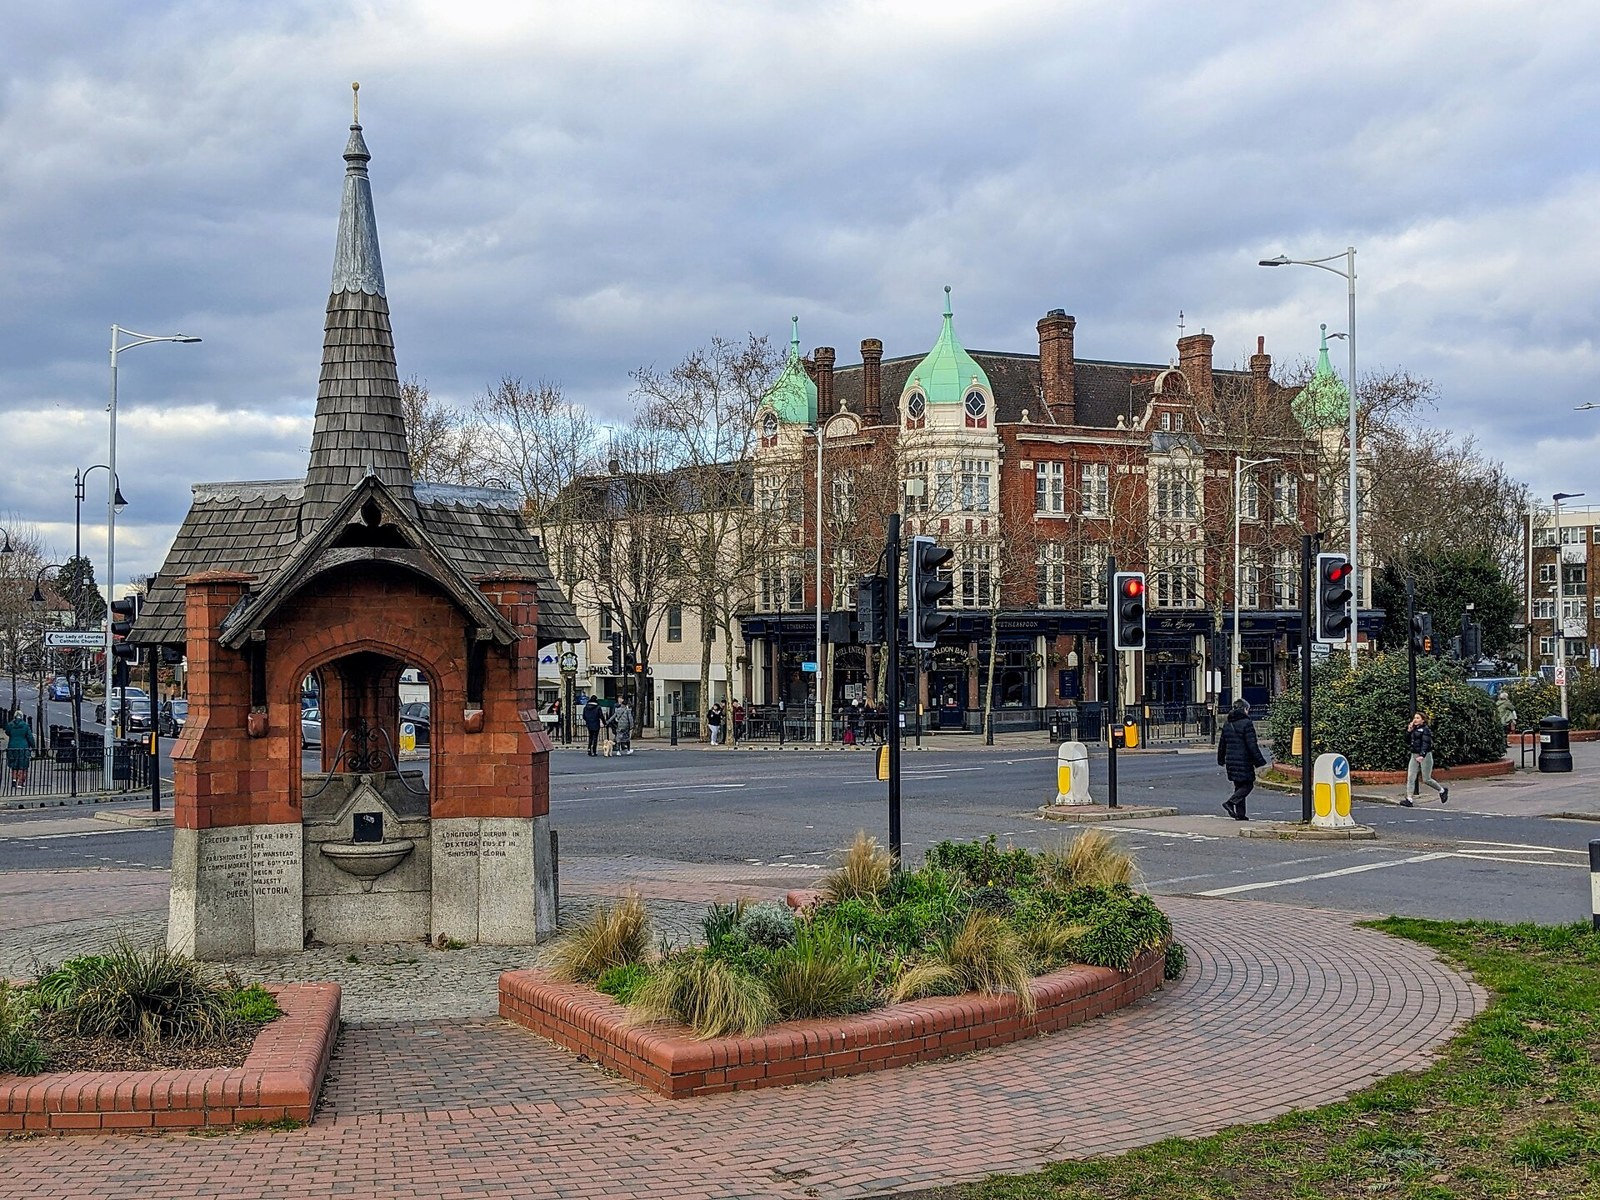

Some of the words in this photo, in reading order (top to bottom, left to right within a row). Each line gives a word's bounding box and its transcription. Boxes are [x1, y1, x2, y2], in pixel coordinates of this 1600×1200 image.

[955, 647, 968, 657] BAR
[206, 854, 247, 862] PARISHIONERS
[208, 862, 250, 870] COMMEMORATE
[227, 890, 248, 900] QUEEN
